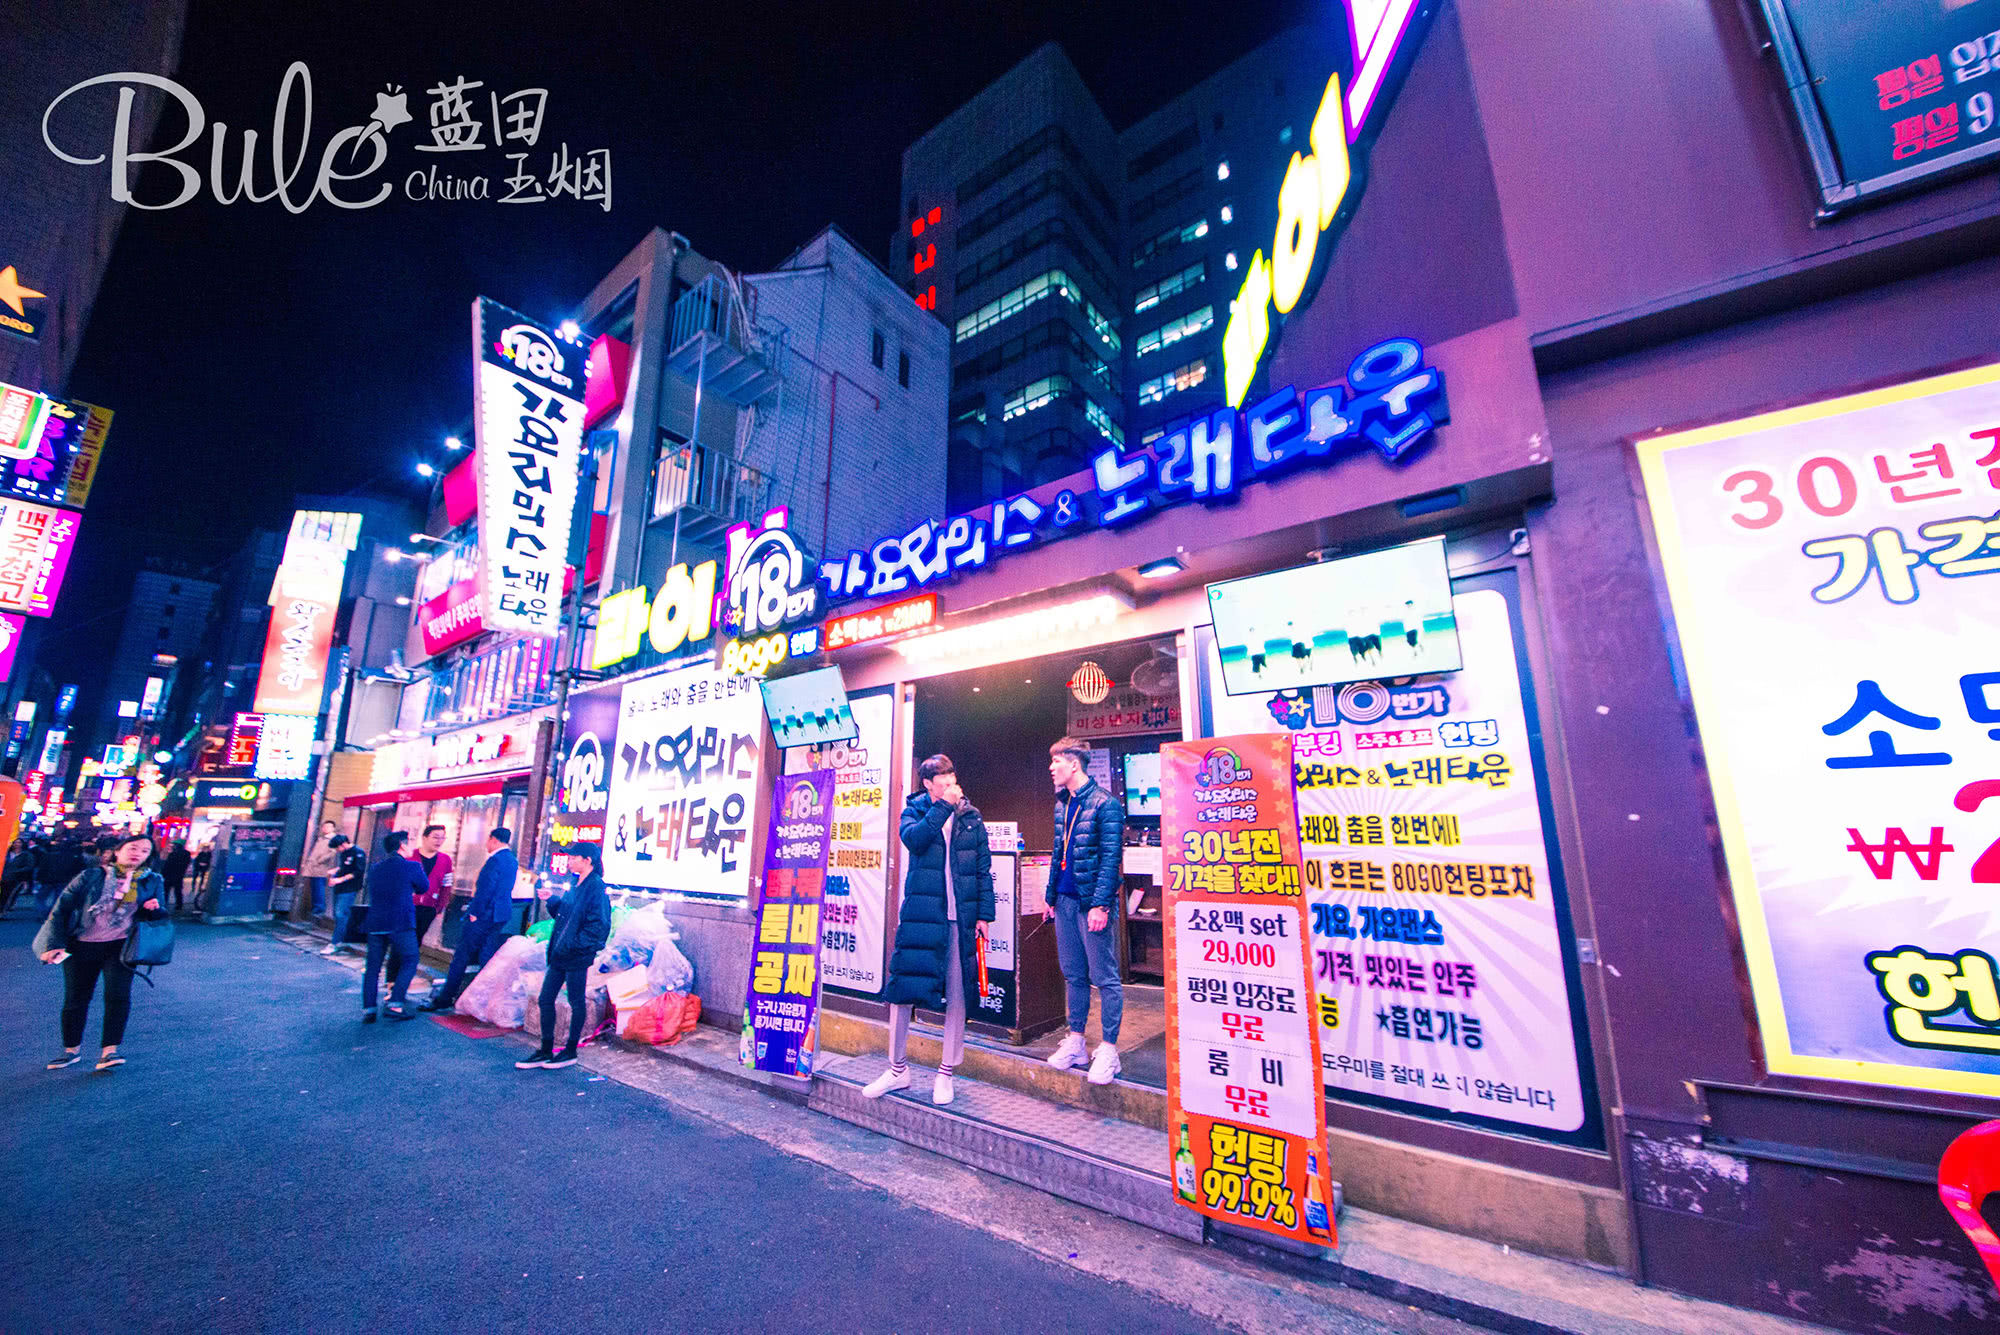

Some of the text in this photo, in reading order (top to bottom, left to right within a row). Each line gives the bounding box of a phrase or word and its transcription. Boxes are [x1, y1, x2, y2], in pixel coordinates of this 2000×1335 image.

[1093, 338, 1442, 526] 노래타운
[722, 632, 788, 677] 8090
[1293, 730, 1342, 758] 부킹
[1438, 719, 1500, 749] 헌팅
[1366, 769, 1382, 785] &
[1384, 752, 1511, 788] 노래타운
[635, 793, 747, 874] 노래타운
[1183, 827, 1283, 864] 30년전
[1299, 815, 1460, 846] 래와 춤을 한번에!
[1168, 863, 1236, 895] 가격을
[1331, 860, 1386, 893] 흐르는
[1188, 908, 1289, 938] 소&맥 set
[1357, 905, 1444, 945] 가요댄스
[1202, 938, 1277, 969] 29,000
[1364, 954, 1426, 993] 맛있는
[1187, 976, 1297, 1014] 평일 입장료
[1221, 1012, 1266, 1043] 무료
[1322, 1052, 1386, 1082] 도우미를
[1390, 1063, 1425, 1089] 절대
[1473, 1077, 1557, 1112] 않습니다
[1225, 1084, 1271, 1119] 무료
[1210, 1122, 1287, 1186] 헌팅
[1202, 1167, 1297, 1228] 99.9%
